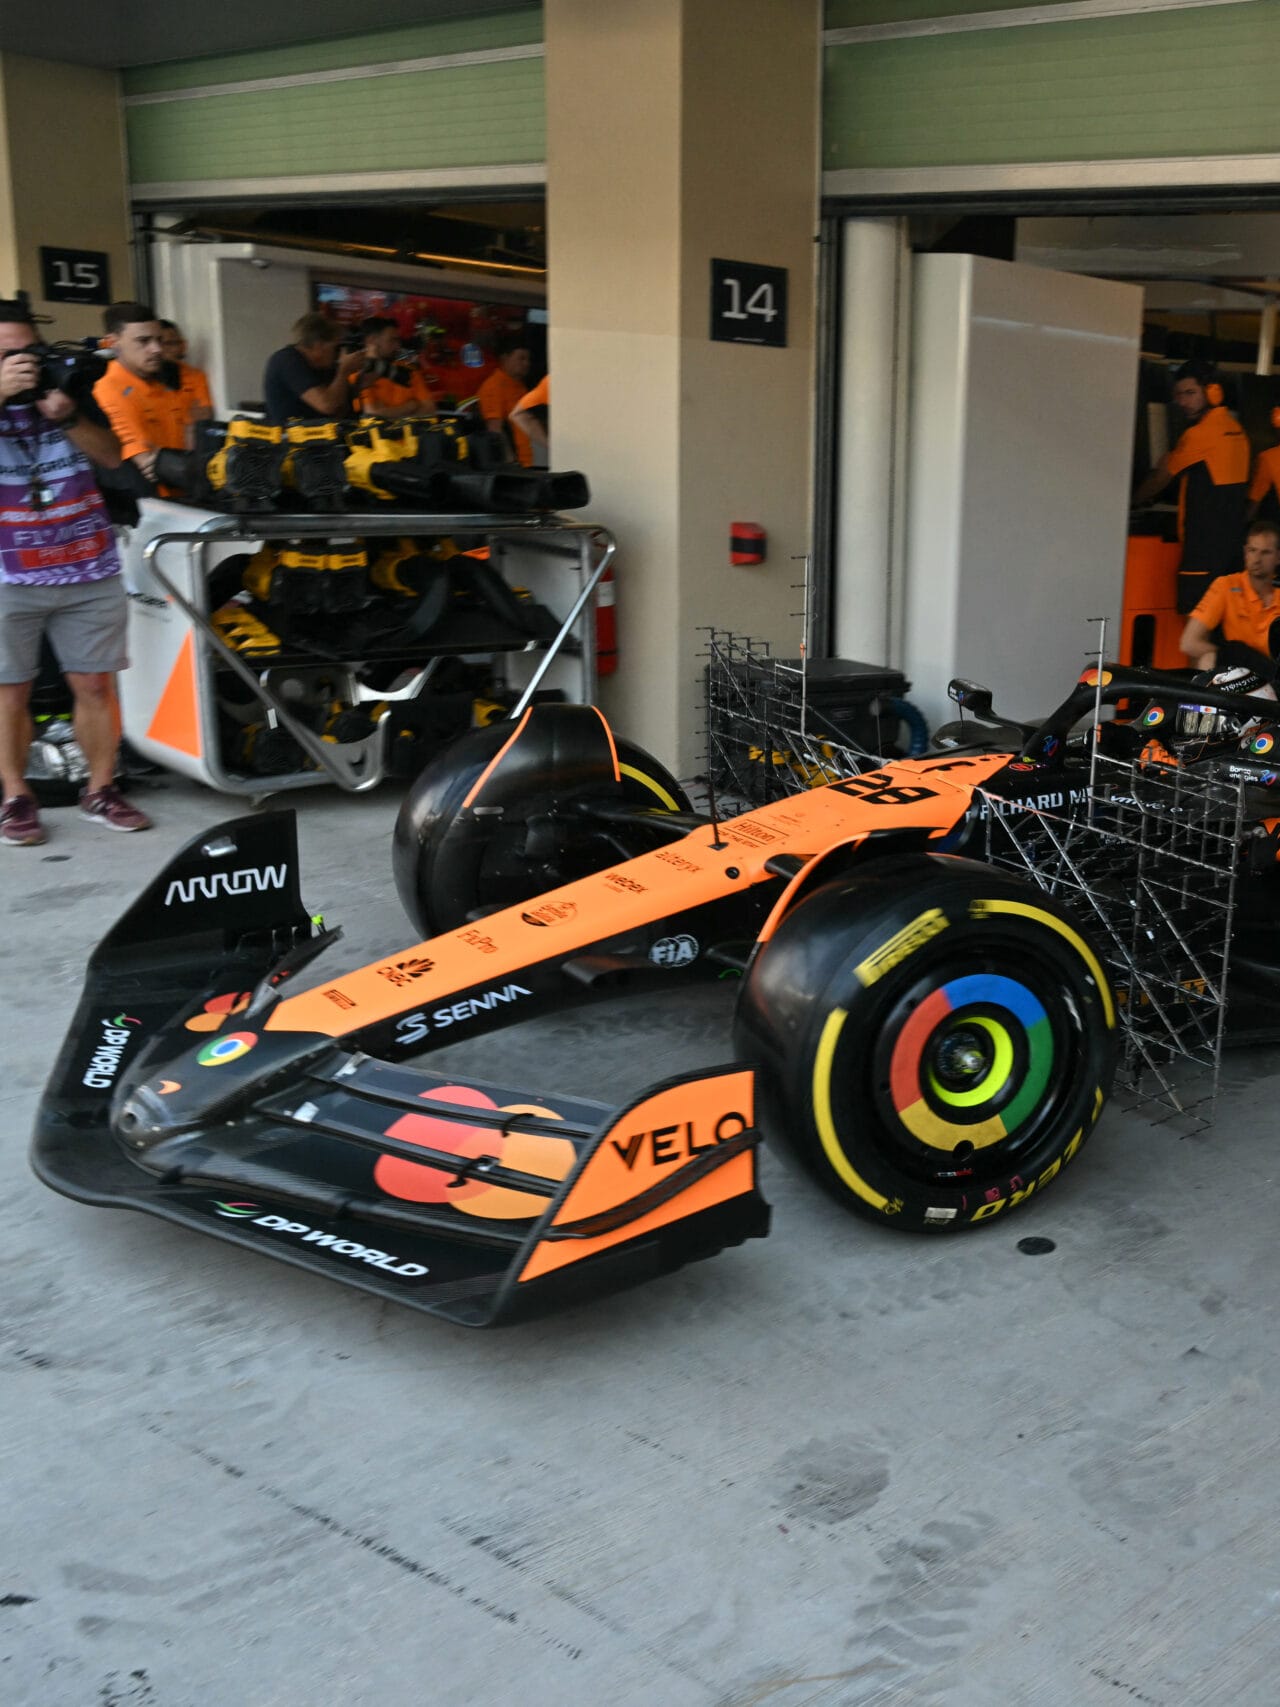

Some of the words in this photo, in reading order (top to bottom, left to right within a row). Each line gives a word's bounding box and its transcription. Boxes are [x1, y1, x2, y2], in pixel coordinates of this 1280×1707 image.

[52, 261, 99, 289] 15
[722, 278, 778, 322] 14
[1229, 772, 1259, 782] enegies
[733, 822, 776, 841] Hilton
[164, 863, 287, 906] ARROW
[605, 872, 649, 895] webex
[456, 929, 499, 955] FxPro
[649, 940, 694, 966] FIA
[432, 984, 534, 1029] SENNA
[102, 1028, 132, 1046] DP
[82, 1045, 126, 1089] WORLD
[611, 1111, 748, 1172] VELO
[250, 1214, 311, 1234] DP
[300, 1230, 430, 1277] WORLD
